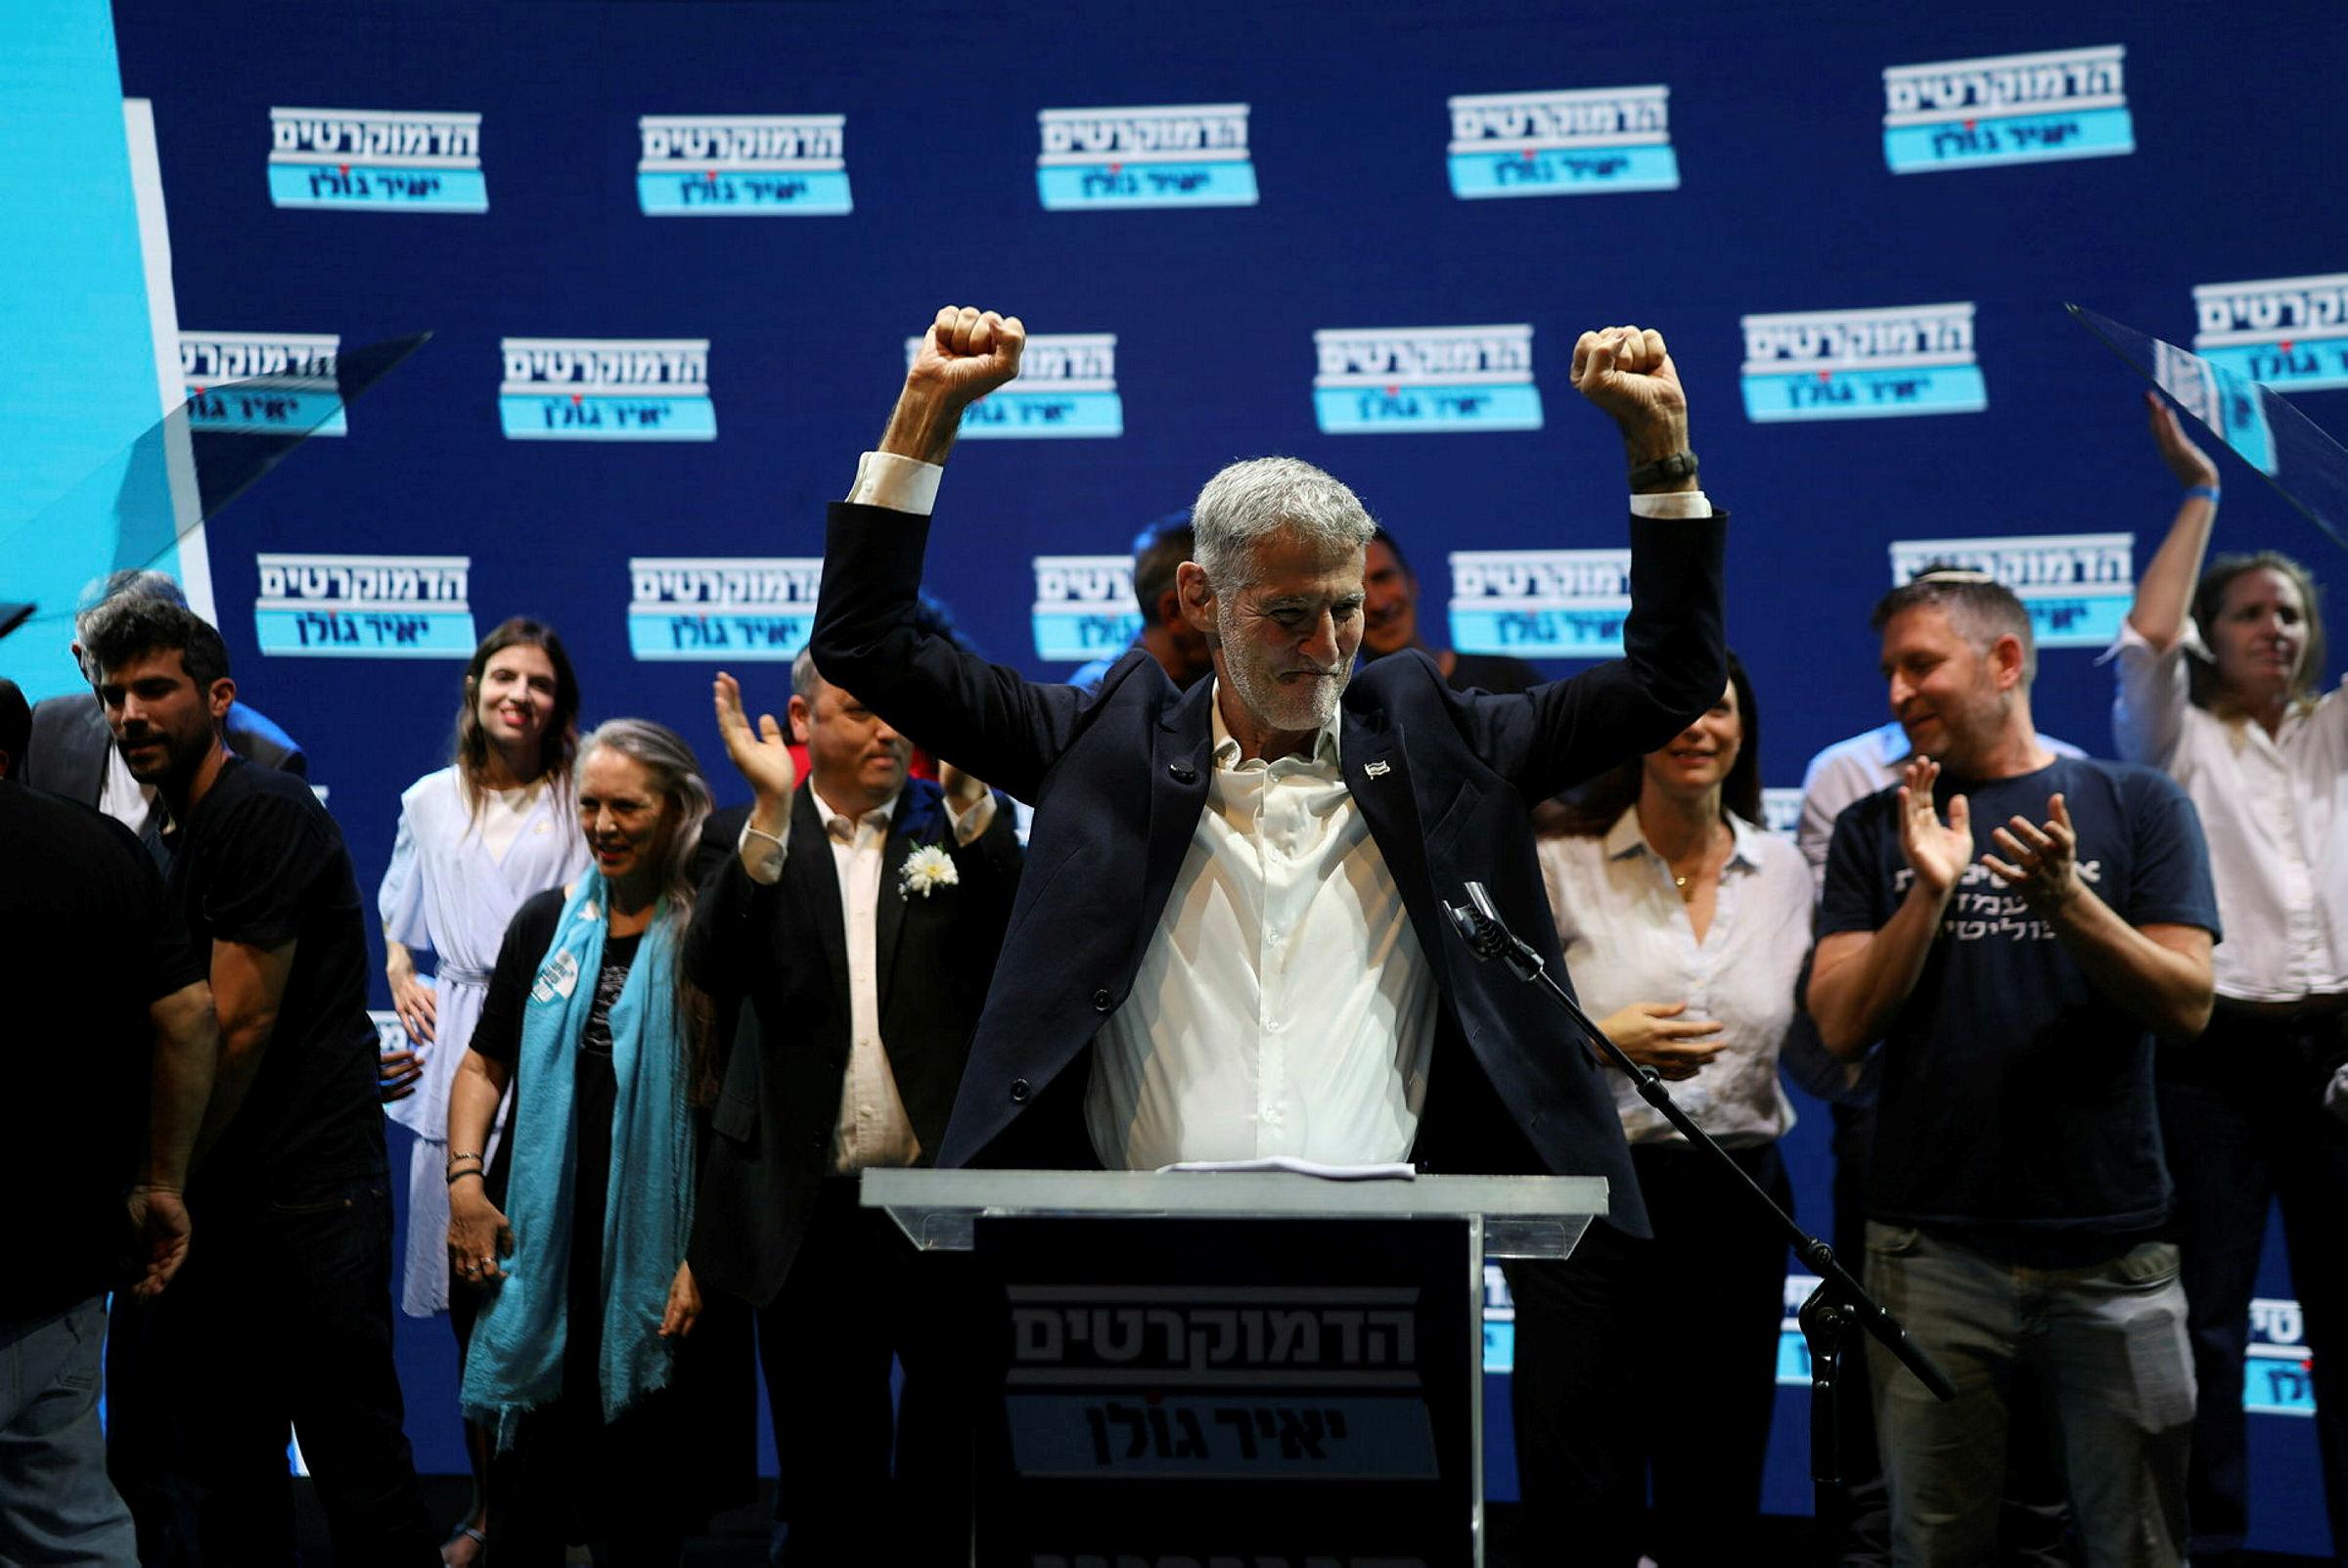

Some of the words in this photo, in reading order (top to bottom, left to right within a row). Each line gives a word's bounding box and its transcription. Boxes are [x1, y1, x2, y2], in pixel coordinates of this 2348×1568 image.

[274, 121, 478, 159] הדמוקרטים
[643, 127, 843, 161] הדמוקרטים
[309, 166, 370, 199] גולן
[2199, 292, 2348, 333] קרטים
[505, 351, 706, 388] הדמוקרטים
[260, 566, 468, 604] הדמוקרטים
[295, 612, 359, 646] גולן
[366, 615, 429, 644] יאיר
[1011, 1308, 1416, 1369] הדמוקרטים
[1086, 1400, 1209, 1465] גולן
[1216, 1409, 1346, 1459] יאיר
